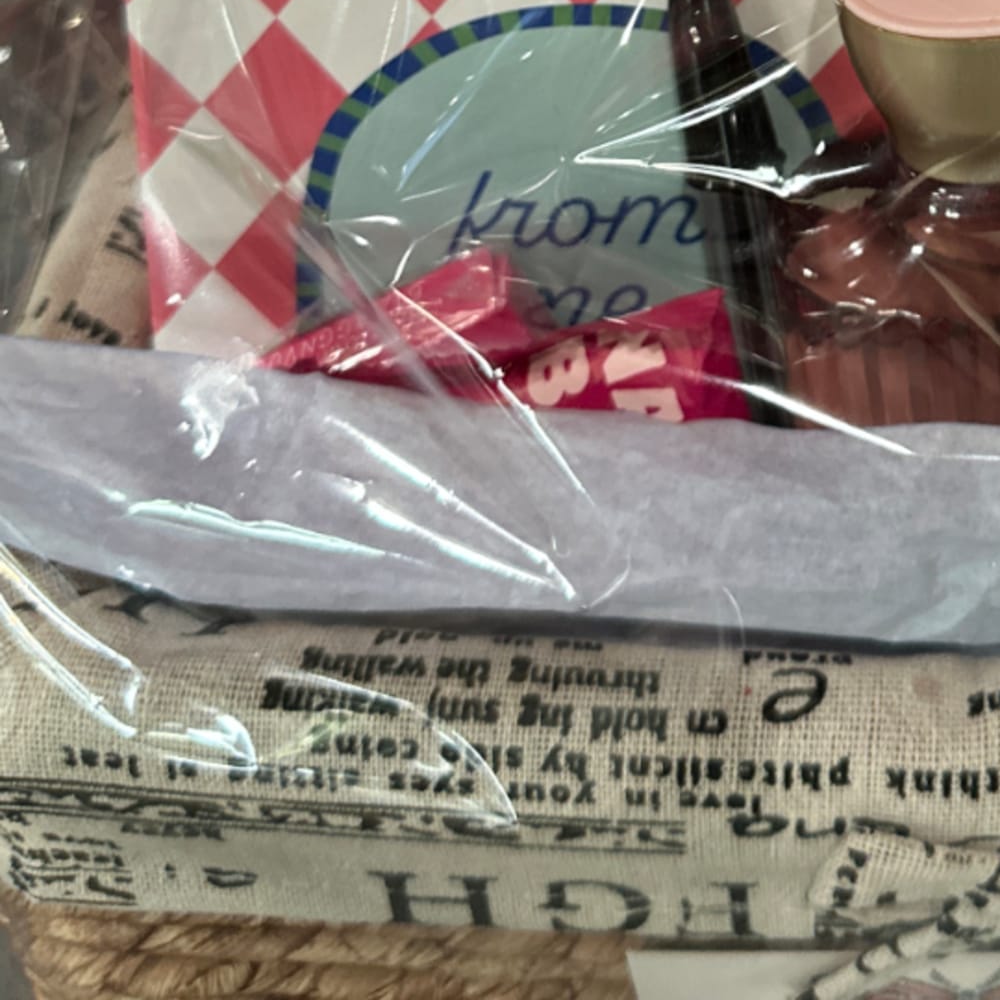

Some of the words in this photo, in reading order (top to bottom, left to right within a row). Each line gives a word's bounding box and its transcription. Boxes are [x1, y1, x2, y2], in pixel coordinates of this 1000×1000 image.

[448, 170, 706, 252] from
[437, 657, 491, 686] the
[886, 766, 1000, 800] think
[624, 786, 662, 813] in
